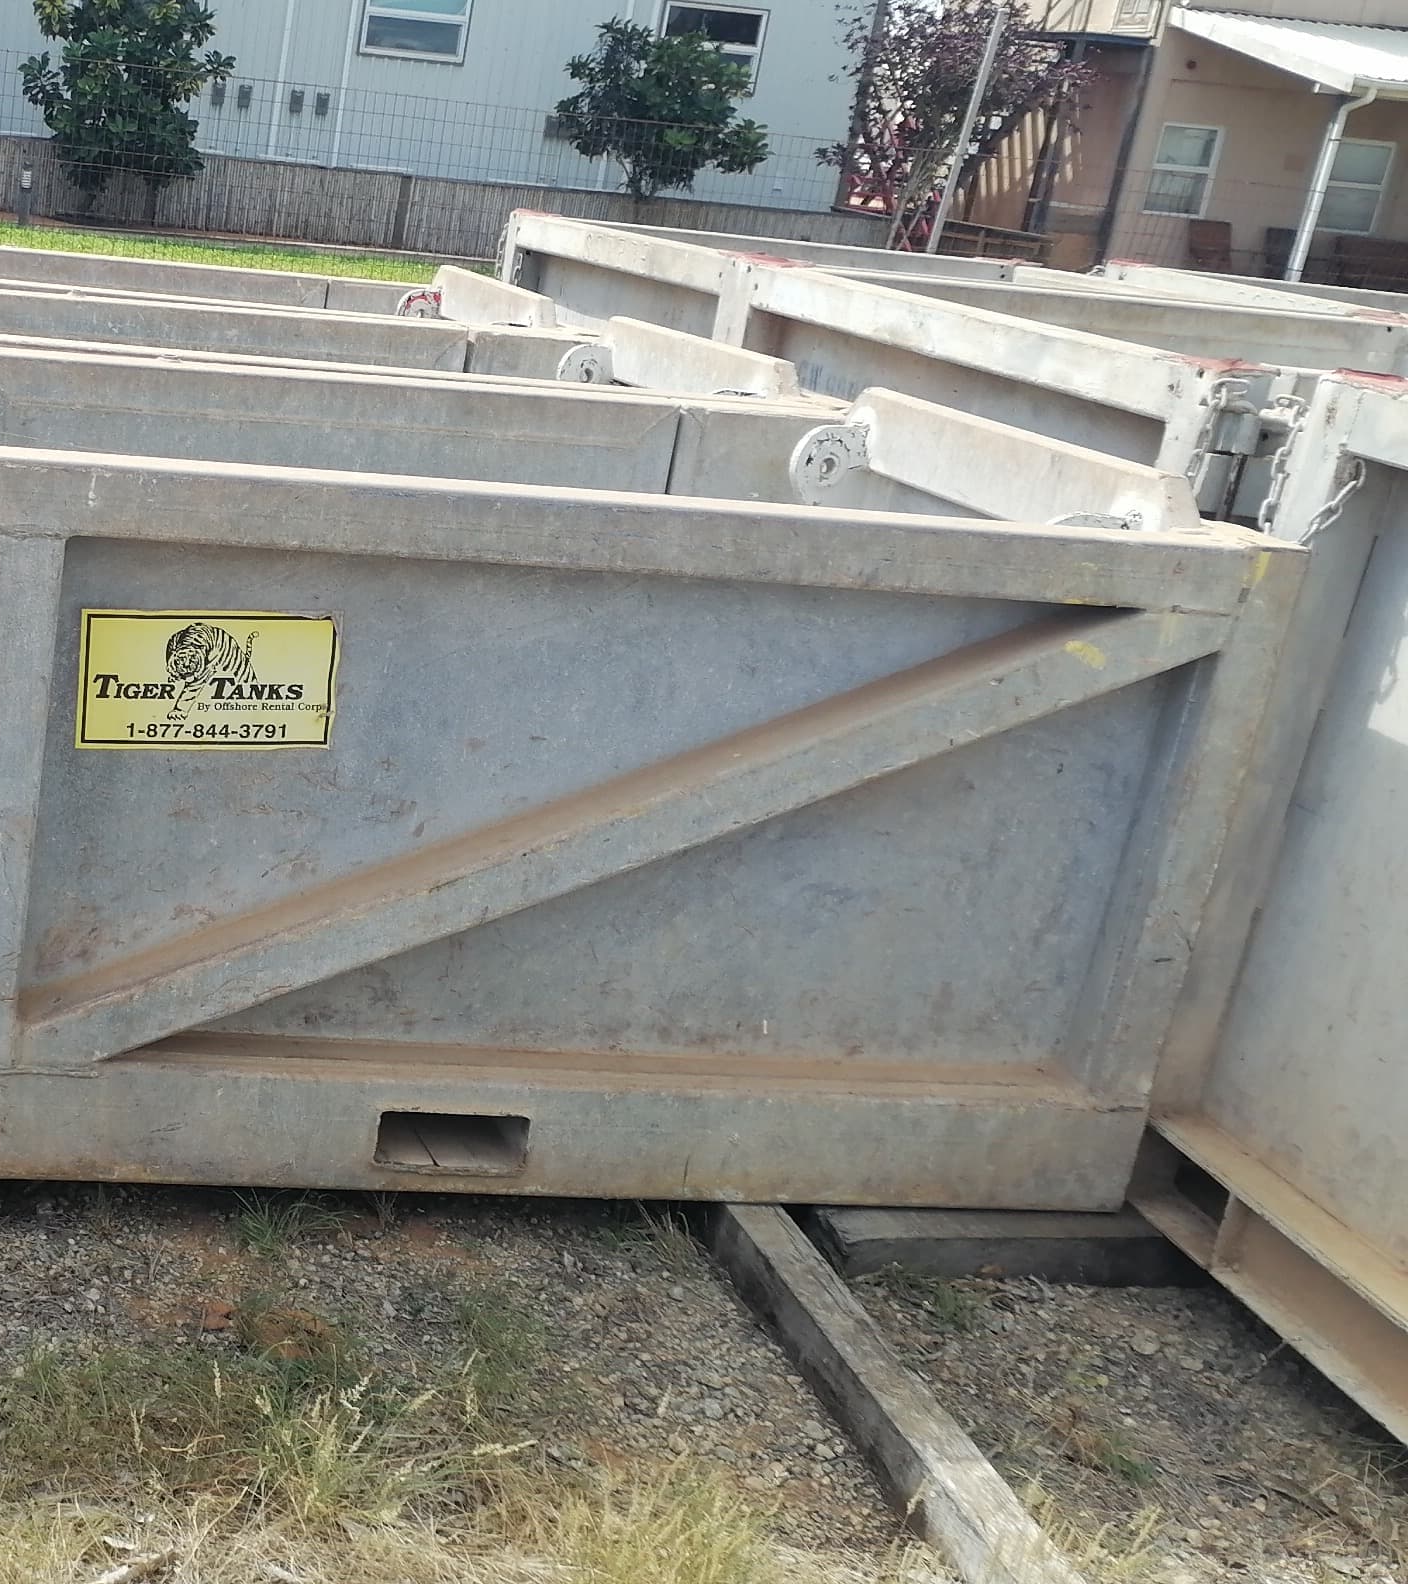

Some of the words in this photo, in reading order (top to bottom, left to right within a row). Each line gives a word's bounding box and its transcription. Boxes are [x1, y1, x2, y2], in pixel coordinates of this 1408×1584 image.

[197, 702, 211, 712] By
[214, 702, 258, 711] Offshore
[261, 702, 295, 711] Rental
[126, 723, 287, 739] 1-877-844-3791
